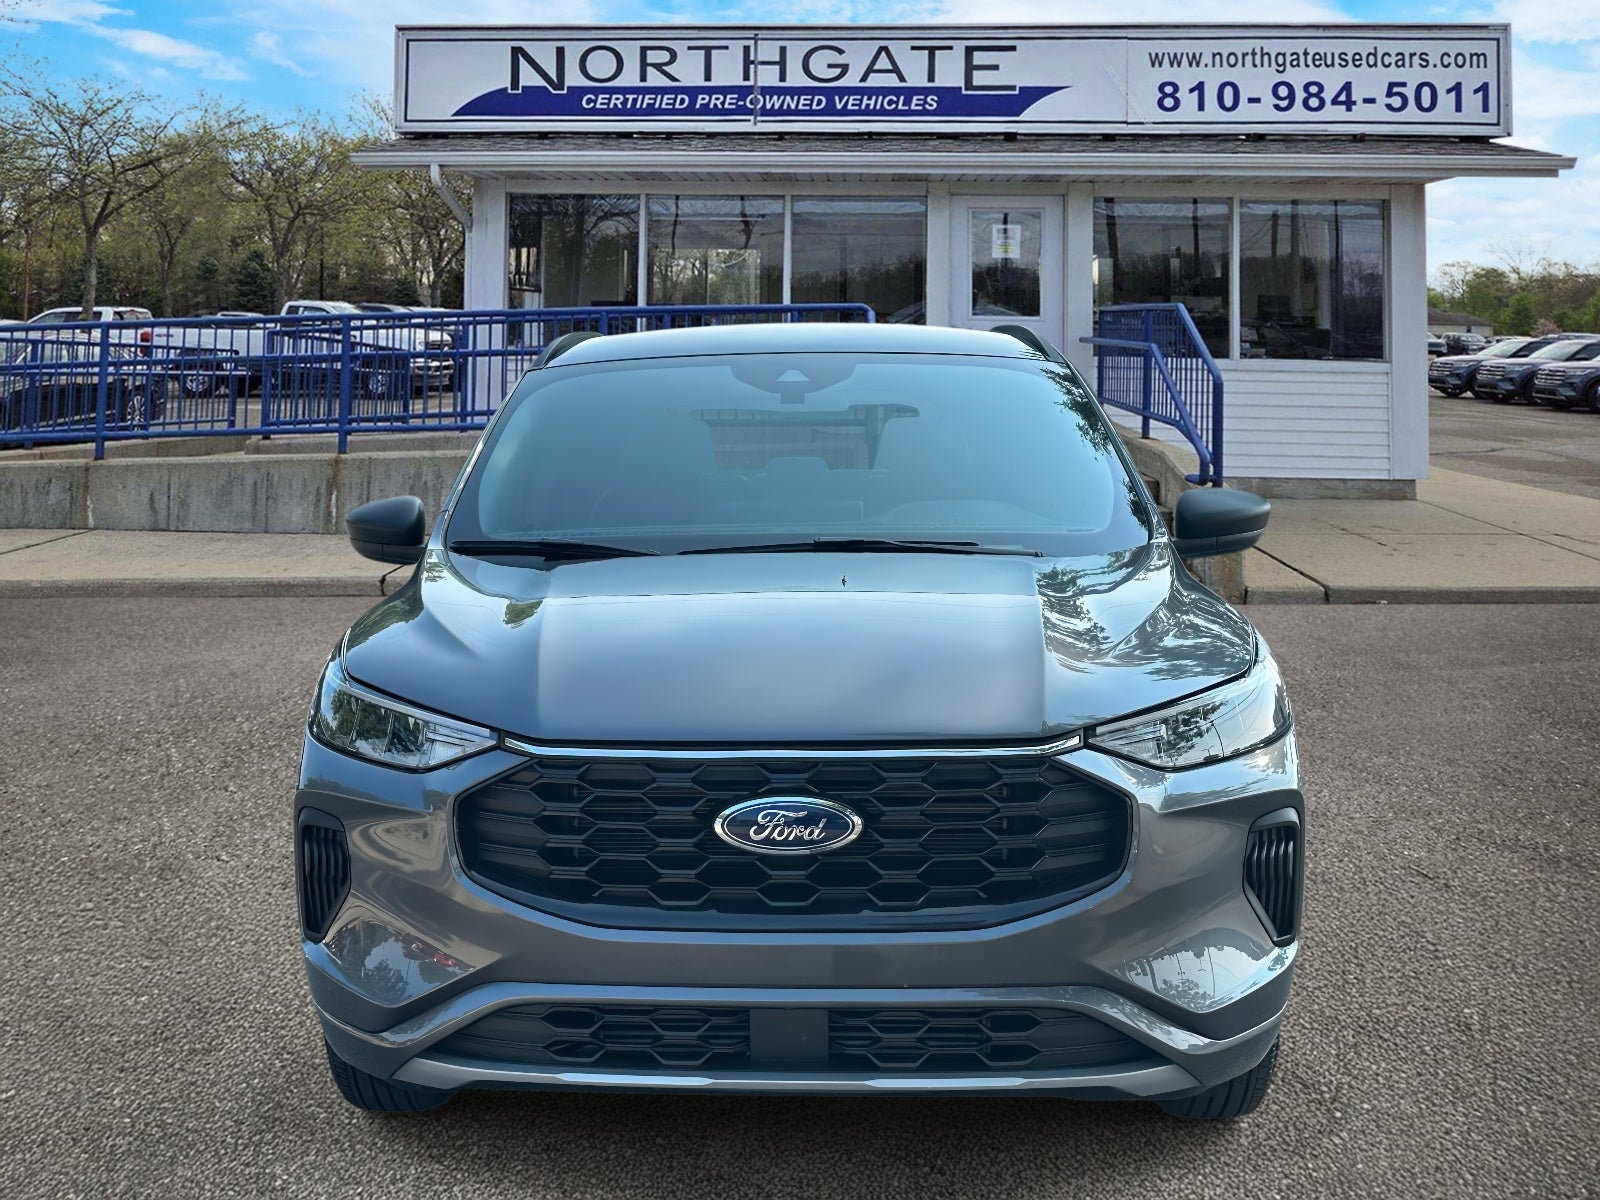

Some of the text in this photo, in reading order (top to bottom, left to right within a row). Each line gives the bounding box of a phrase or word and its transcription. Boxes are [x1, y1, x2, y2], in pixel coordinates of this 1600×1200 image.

[510, 45, 1017, 92] NORTHGATE
[1148, 46, 1488, 73] www.northgateusedcars.com
[581, 93, 938, 111] CERTIFIED PRE-OWNED VEHICLES
[1156, 80, 1491, 113] 810-984-5011
[749, 809, 828, 841] Ford
